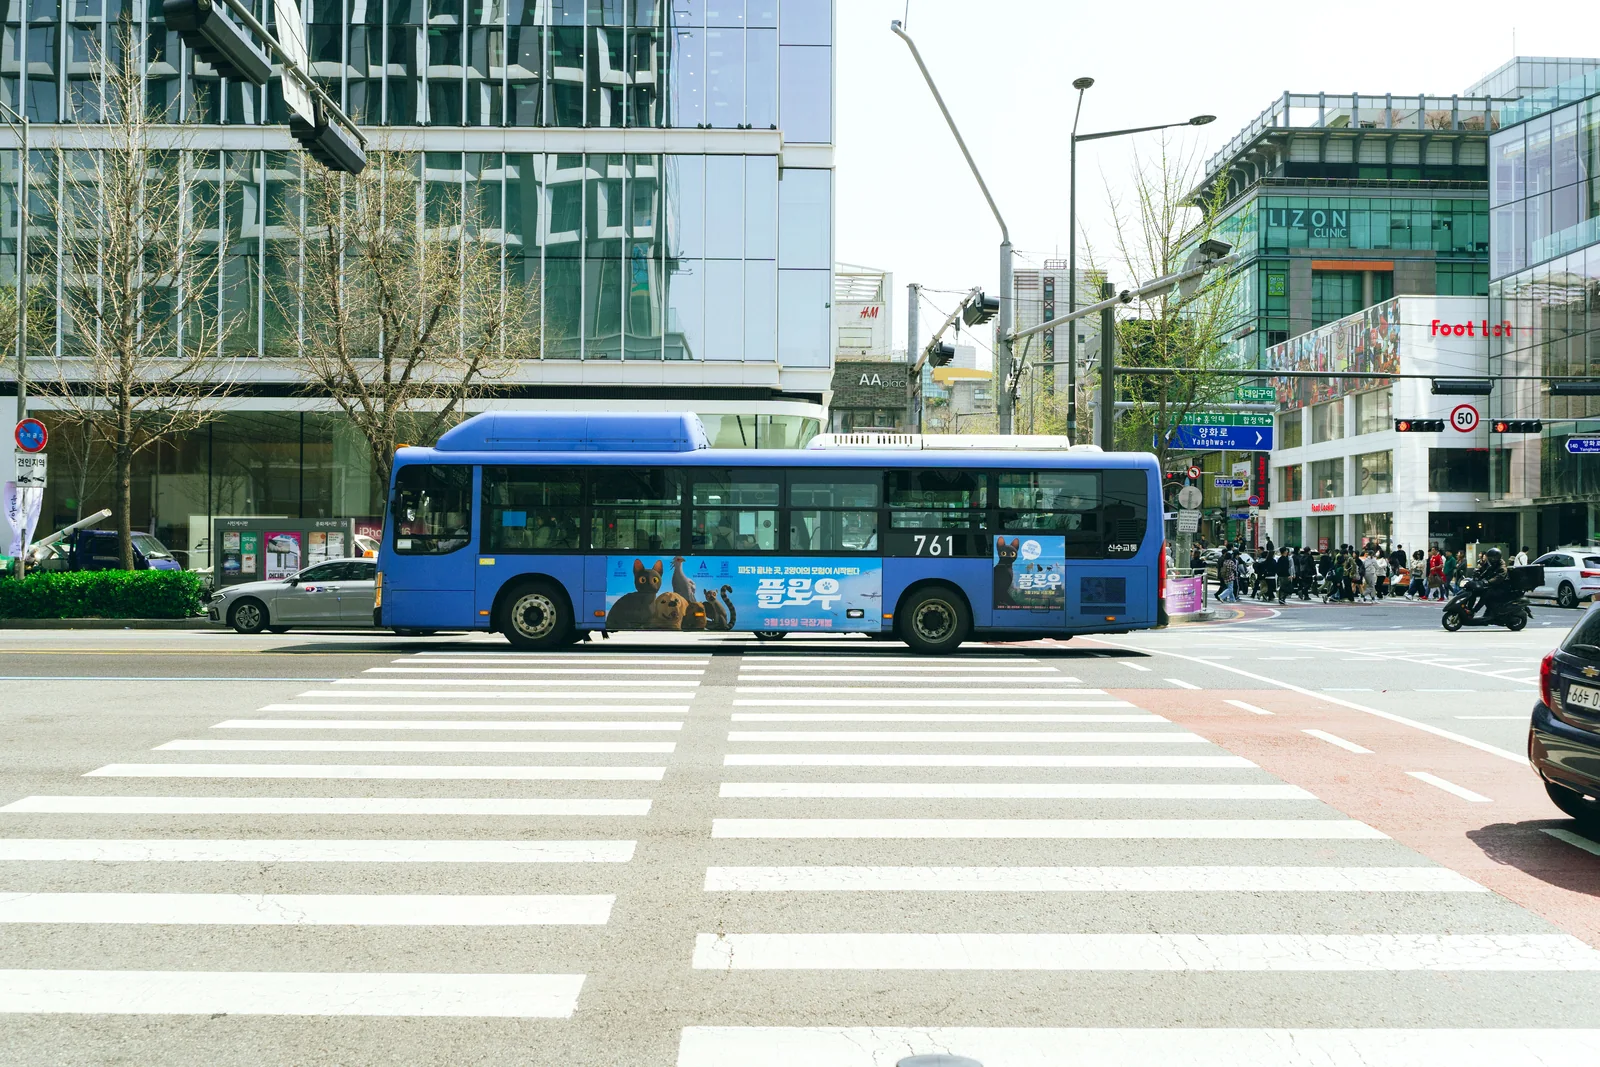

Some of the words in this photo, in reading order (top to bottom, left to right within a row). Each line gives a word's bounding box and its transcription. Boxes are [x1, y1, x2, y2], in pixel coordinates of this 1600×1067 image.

[1269, 209, 1346, 228] LIZON
[1314, 228, 1347, 238] CLINIC
[860, 306, 879, 319] H&M
[1431, 319, 1475, 337] Foot
[1204, 415, 1225, 424] 홍익대
[1243, 416, 1264, 425] 합정역
[1457, 412, 1473, 425] 50
[1199, 427, 1229, 438] 양화로
[1192, 438, 1236, 447] Yanghwa-ro
[17, 458, 45, 468] 견인지역
[914, 535, 953, 556] 761
[1107, 544, 1138, 552] 신수교통
[1019, 573, 1062, 590] 플로우
[756, 578, 841, 610] 플로우
[764, 618, 778, 627] 3월
[779, 618, 798, 627] 19일
[800, 618, 833, 627] 극장개봉
